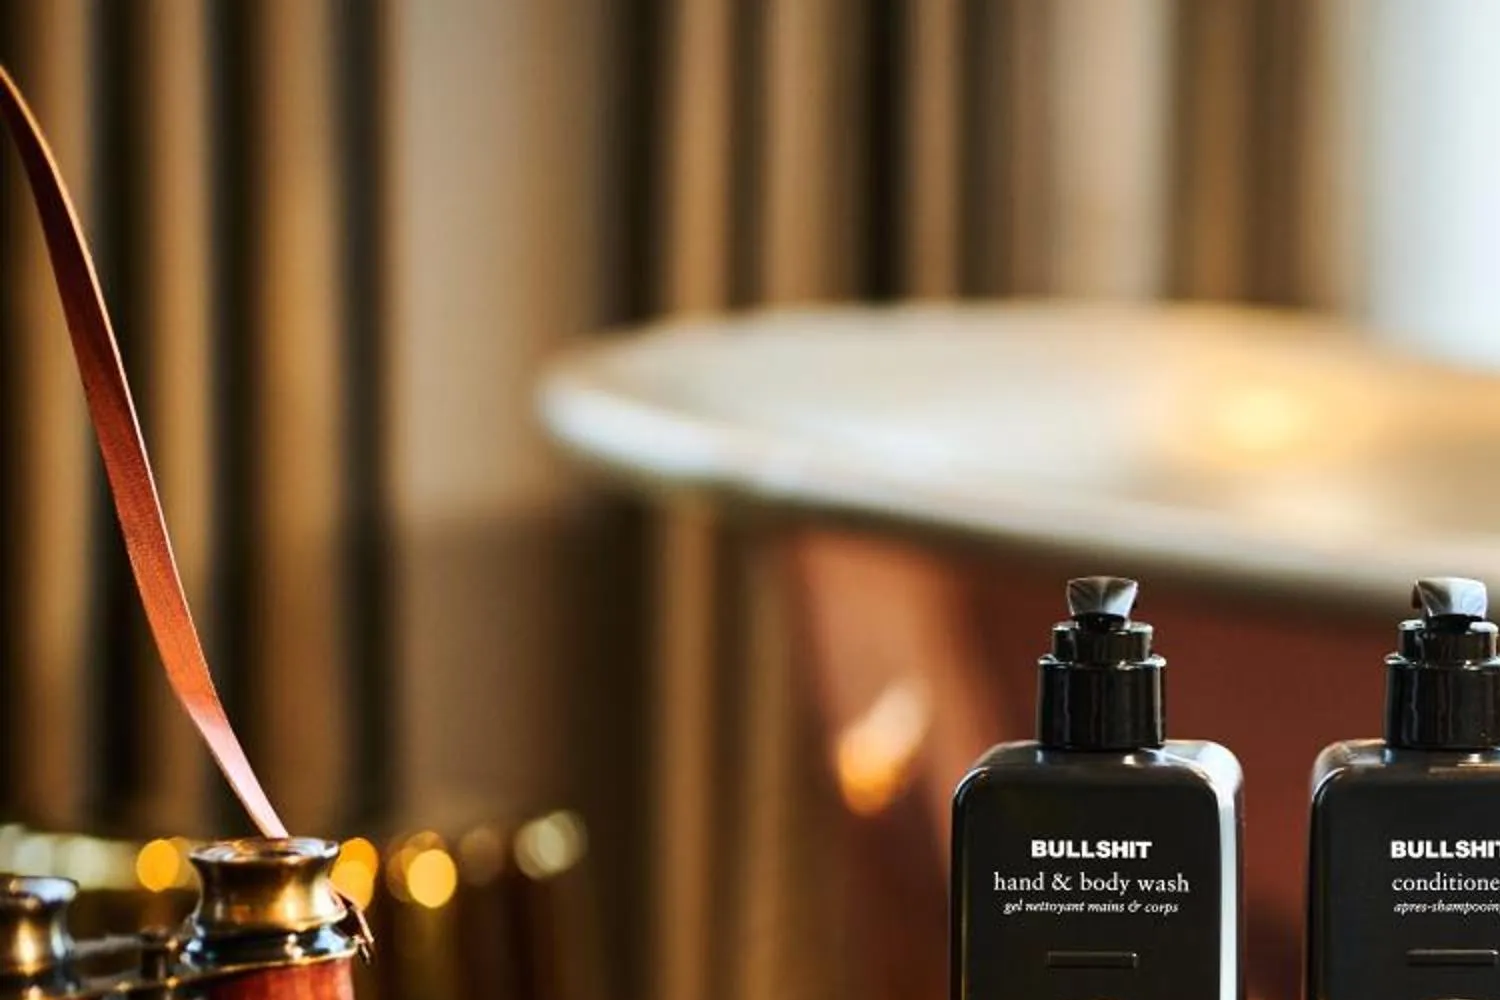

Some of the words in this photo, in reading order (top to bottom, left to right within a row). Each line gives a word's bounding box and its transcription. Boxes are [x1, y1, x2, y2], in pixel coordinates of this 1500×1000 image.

[1031, 840, 1152, 859] BULLSHIT
[994, 872, 1044, 890] hand
[1052, 873, 1072, 891] &
[1080, 872, 1130, 896] body
[1137, 873, 1189, 892] wash
[1003, 898, 1023, 914] gel
[1025, 901, 1084, 914] nettoyant
[1088, 901, 1124, 912] mains
[1128, 900, 1142, 912] &
[1144, 904, 1178, 916] corps
